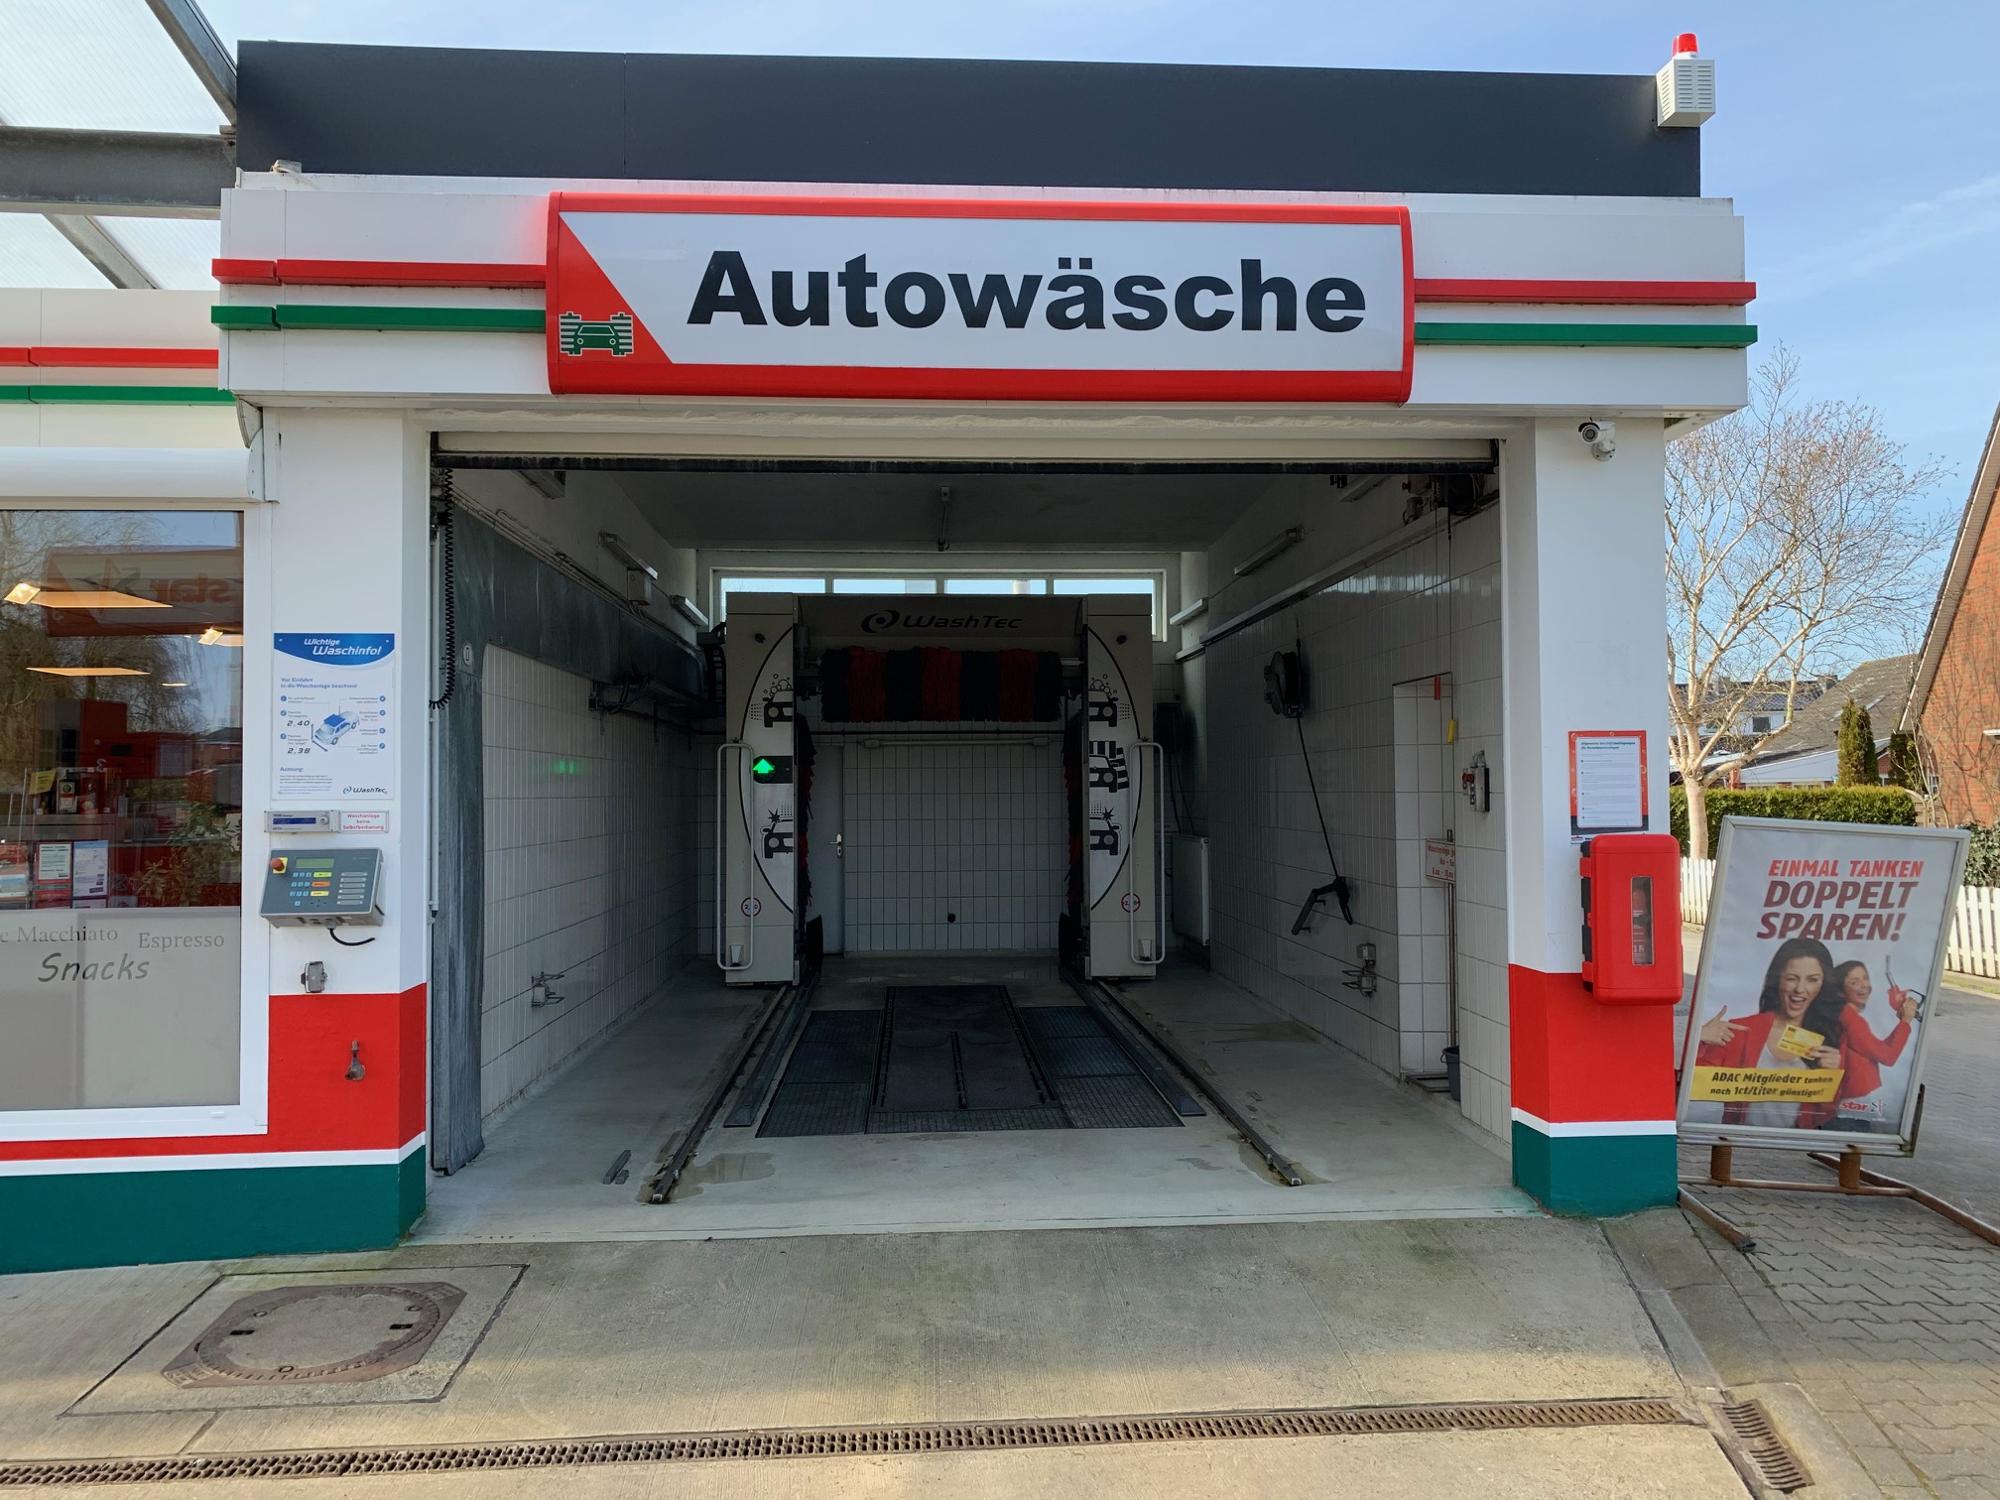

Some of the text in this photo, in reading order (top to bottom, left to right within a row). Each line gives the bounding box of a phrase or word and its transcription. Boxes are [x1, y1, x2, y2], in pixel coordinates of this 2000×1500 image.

[687, 251, 1366, 333] Autowäsche
[903, 615, 1023, 628] WashTec
[304, 638, 340, 646] Wichtige
[312, 646, 382, 656] Waschinfo!
[1768, 859, 1925, 878] EINMAL TANKEN
[1764, 880, 1919, 909] DOPPELT
[1757, 911, 1907, 942] SPAREN!
[17, 926, 119, 943] Macchiato
[138, 931, 225, 952] Espresso
[37, 952, 150, 983] Snacks
[1712, 1072, 1740, 1083] ADAC
[1743, 1073, 1802, 1085] Mitglieder
[1710, 1086, 1825, 1098] noch 1ct/Liter günstiger!
[1840, 1102, 1868, 1111] star
